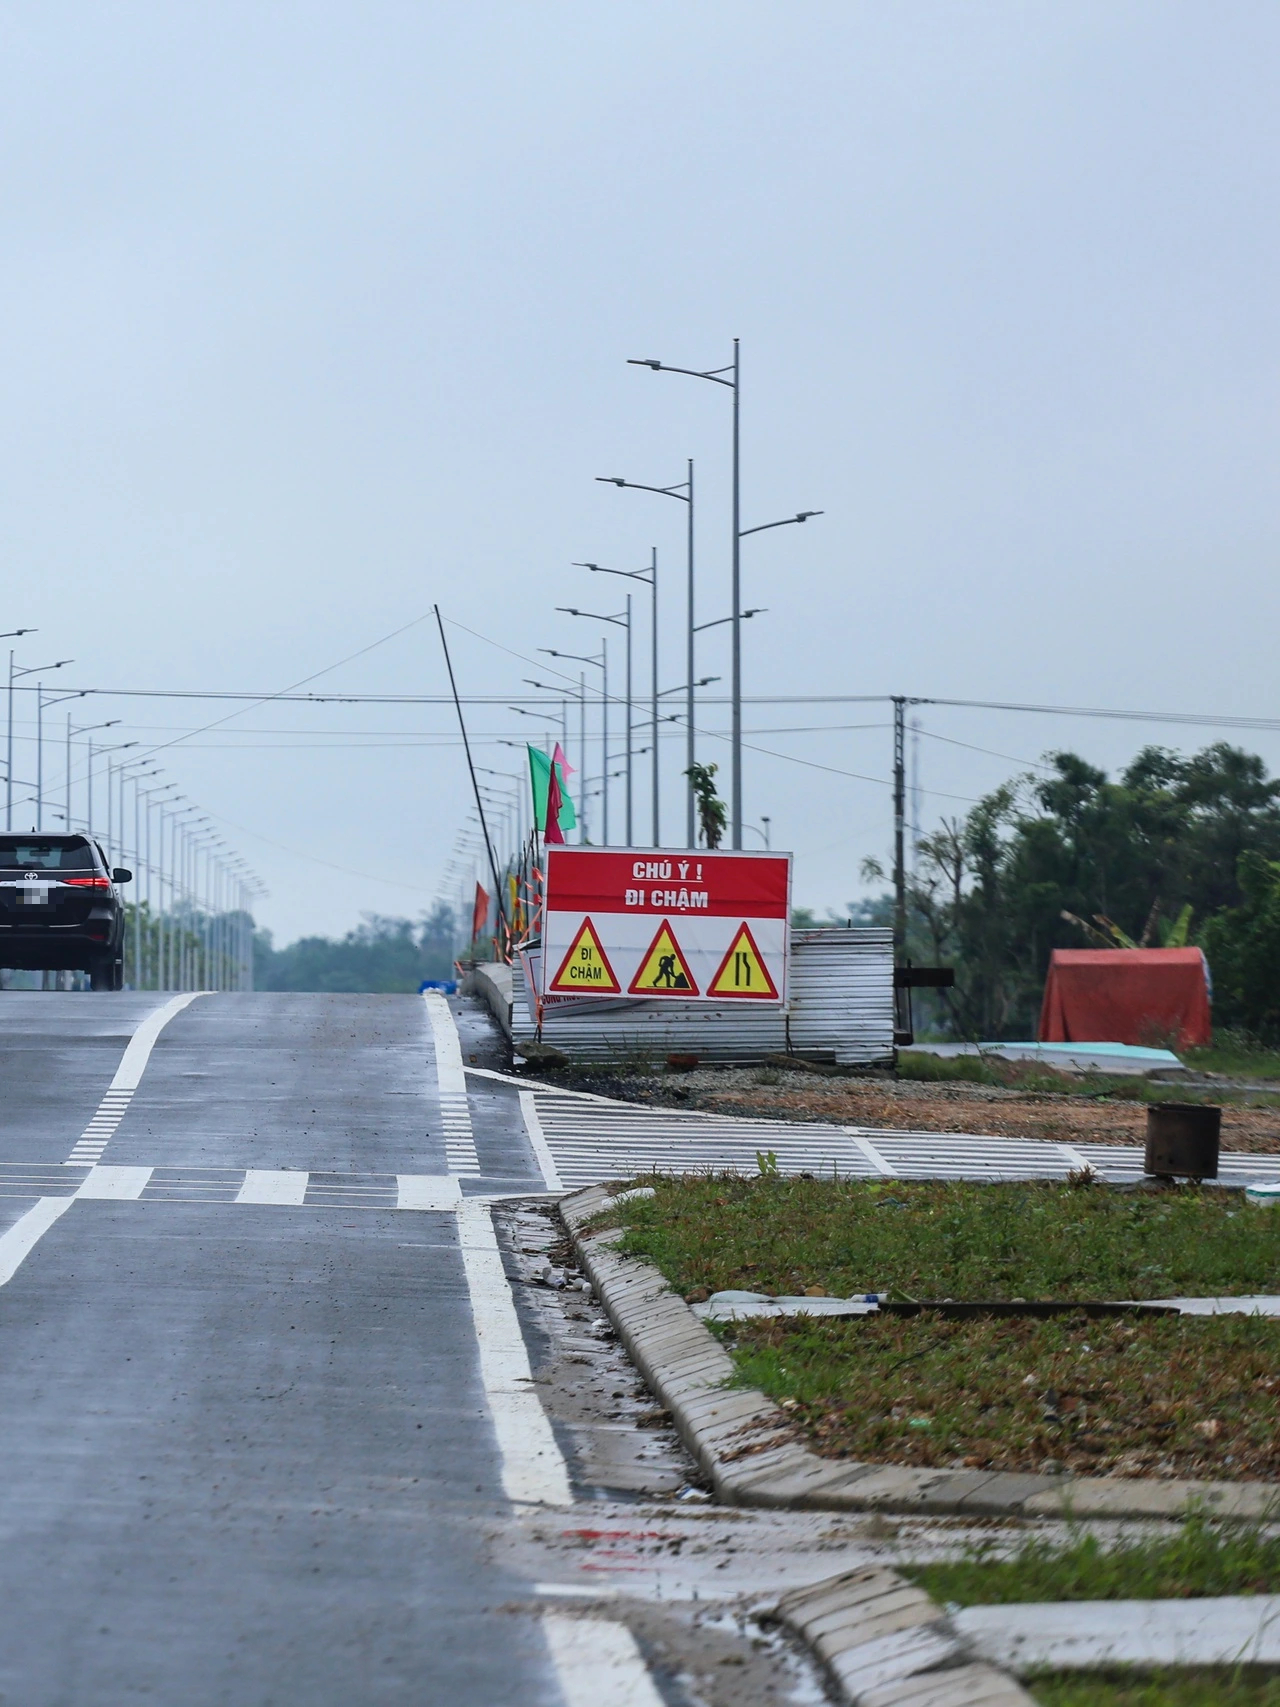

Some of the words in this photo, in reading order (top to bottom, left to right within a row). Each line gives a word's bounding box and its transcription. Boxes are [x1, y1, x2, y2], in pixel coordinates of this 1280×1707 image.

[632, 859, 672, 879] CHÚ
[677, 859, 690, 880] Ý
[625, 889, 645, 906] ĐI
[651, 887, 709, 911] CHẬM
[581, 947, 592, 960] ĐI
[570, 963, 602, 982] CHẬM
